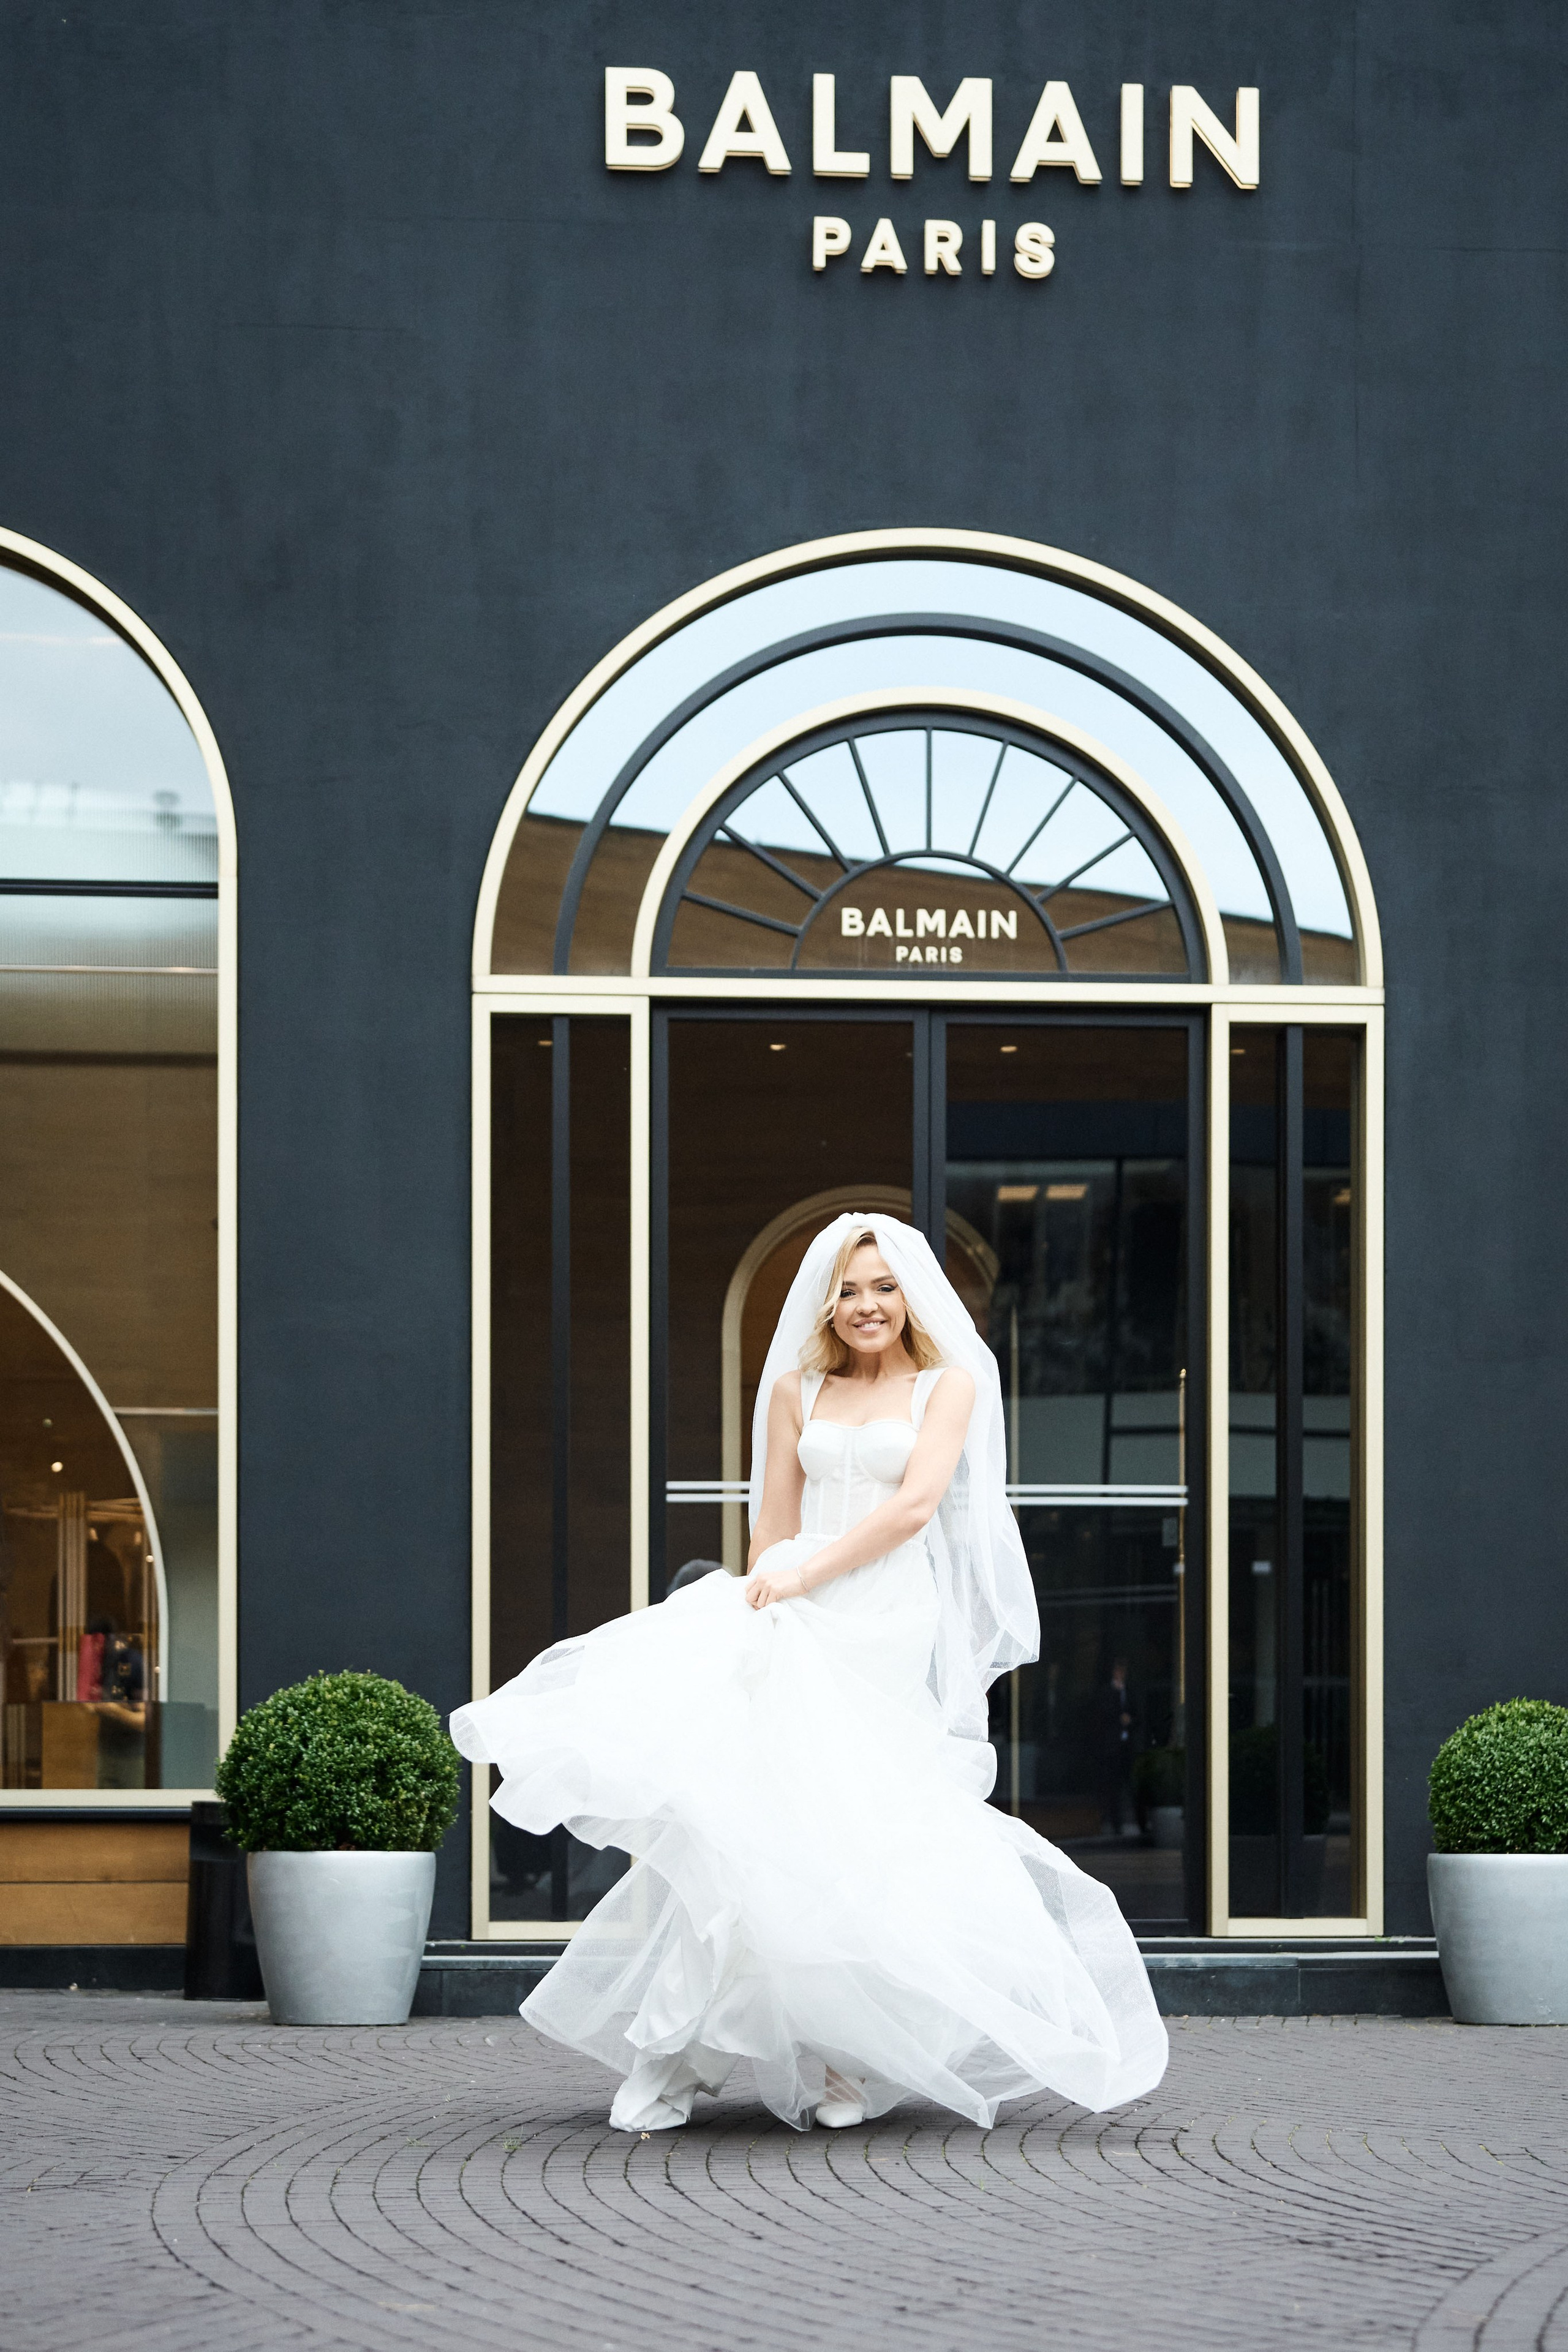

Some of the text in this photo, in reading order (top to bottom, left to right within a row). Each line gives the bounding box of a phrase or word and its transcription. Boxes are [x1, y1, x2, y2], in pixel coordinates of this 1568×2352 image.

[605, 66, 1260, 190] BALMAIN
[812, 216, 1055, 279] PARIS
[841, 907, 1017, 939] BALMAIN
[895, 945, 963, 963] PARIS
